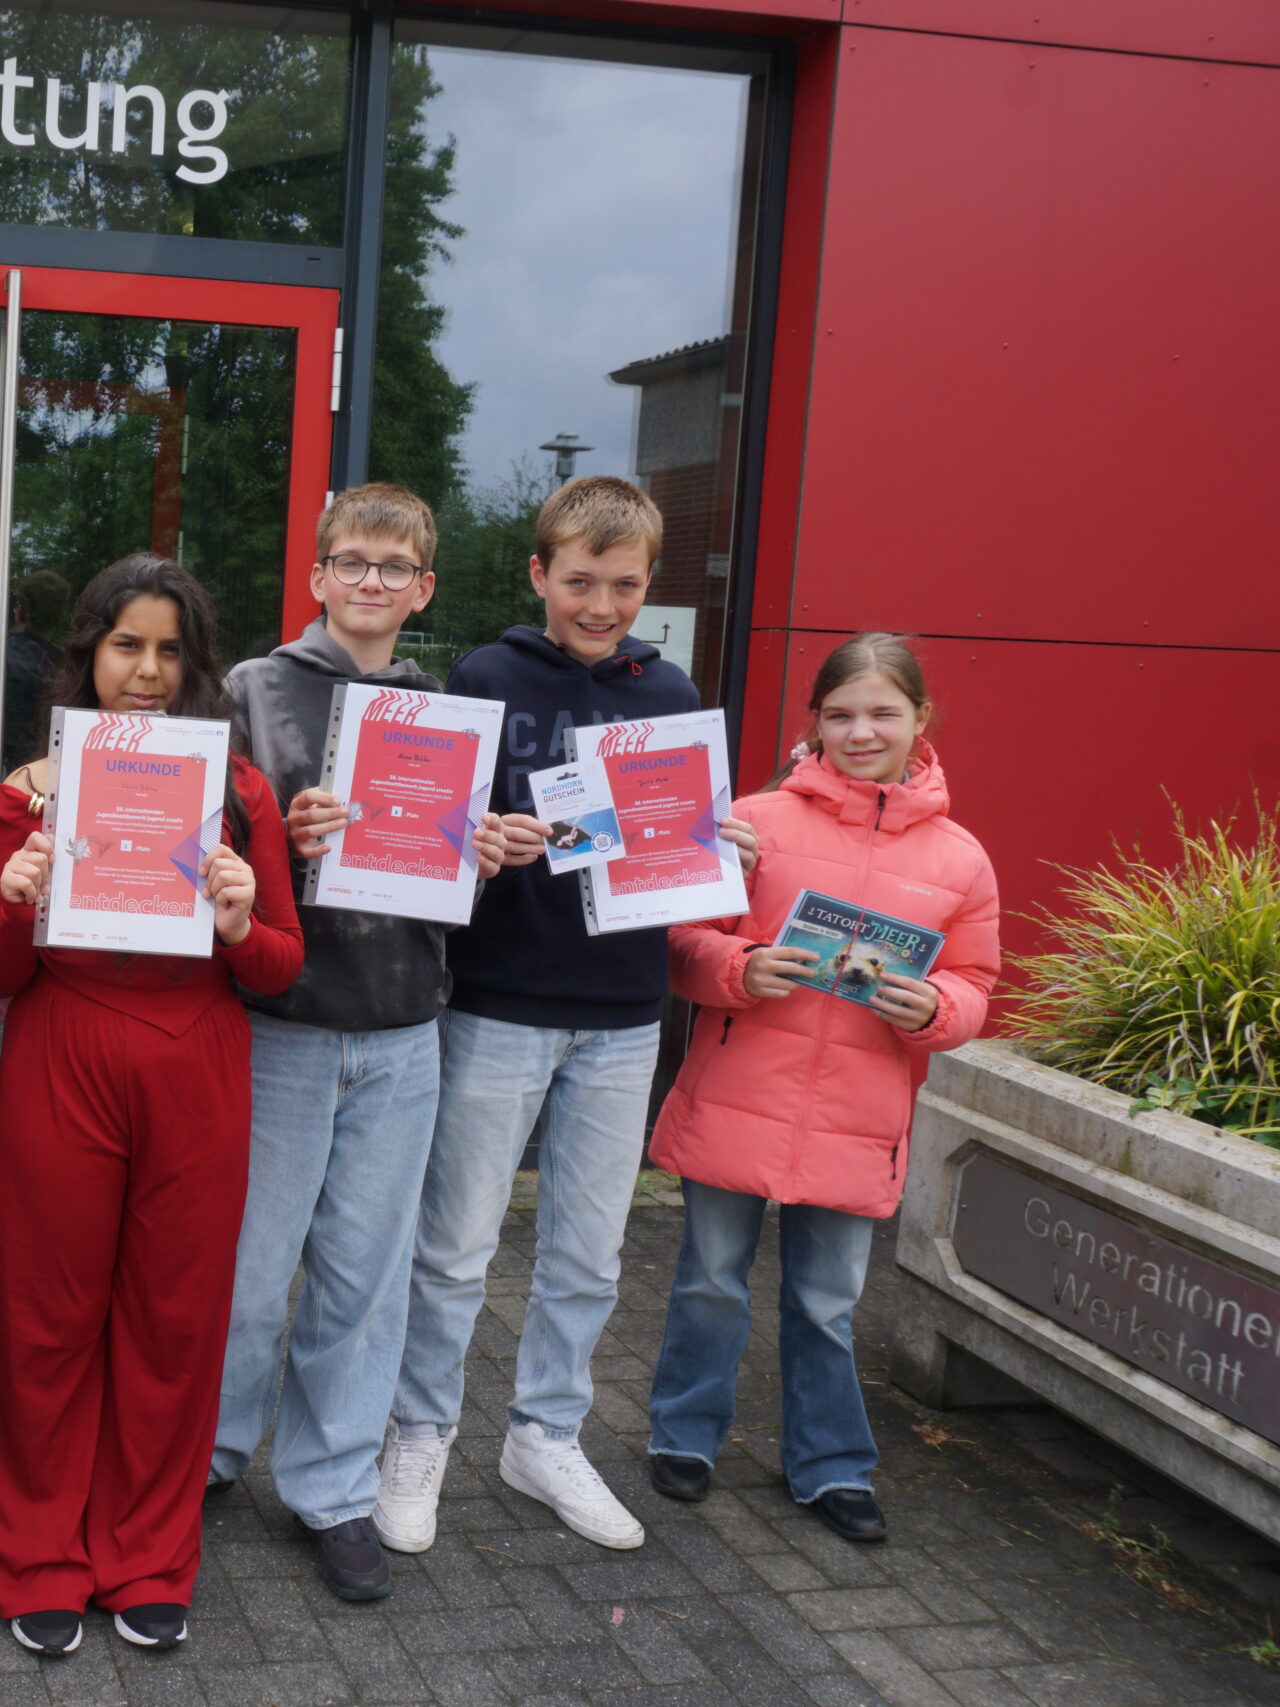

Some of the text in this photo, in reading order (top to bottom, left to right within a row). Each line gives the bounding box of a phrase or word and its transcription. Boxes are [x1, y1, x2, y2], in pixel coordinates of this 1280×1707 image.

[382, 730, 455, 751] URKUNDE
[106, 759, 181, 777] URKUNDE
[618, 754, 688, 774] URKUNDE
[541, 779, 583, 796] NORDHORN
[543, 786, 585, 803] GUTSCHEIN
[340, 853, 460, 882] entdecken
[610, 868, 723, 896] entdecken
[69, 892, 195, 917] entdecken
[816, 908, 920, 952] TATORT MEER
[1024, 1196, 1280, 1359] Generatione
[1052, 1262, 1245, 1404] Werkstatt
